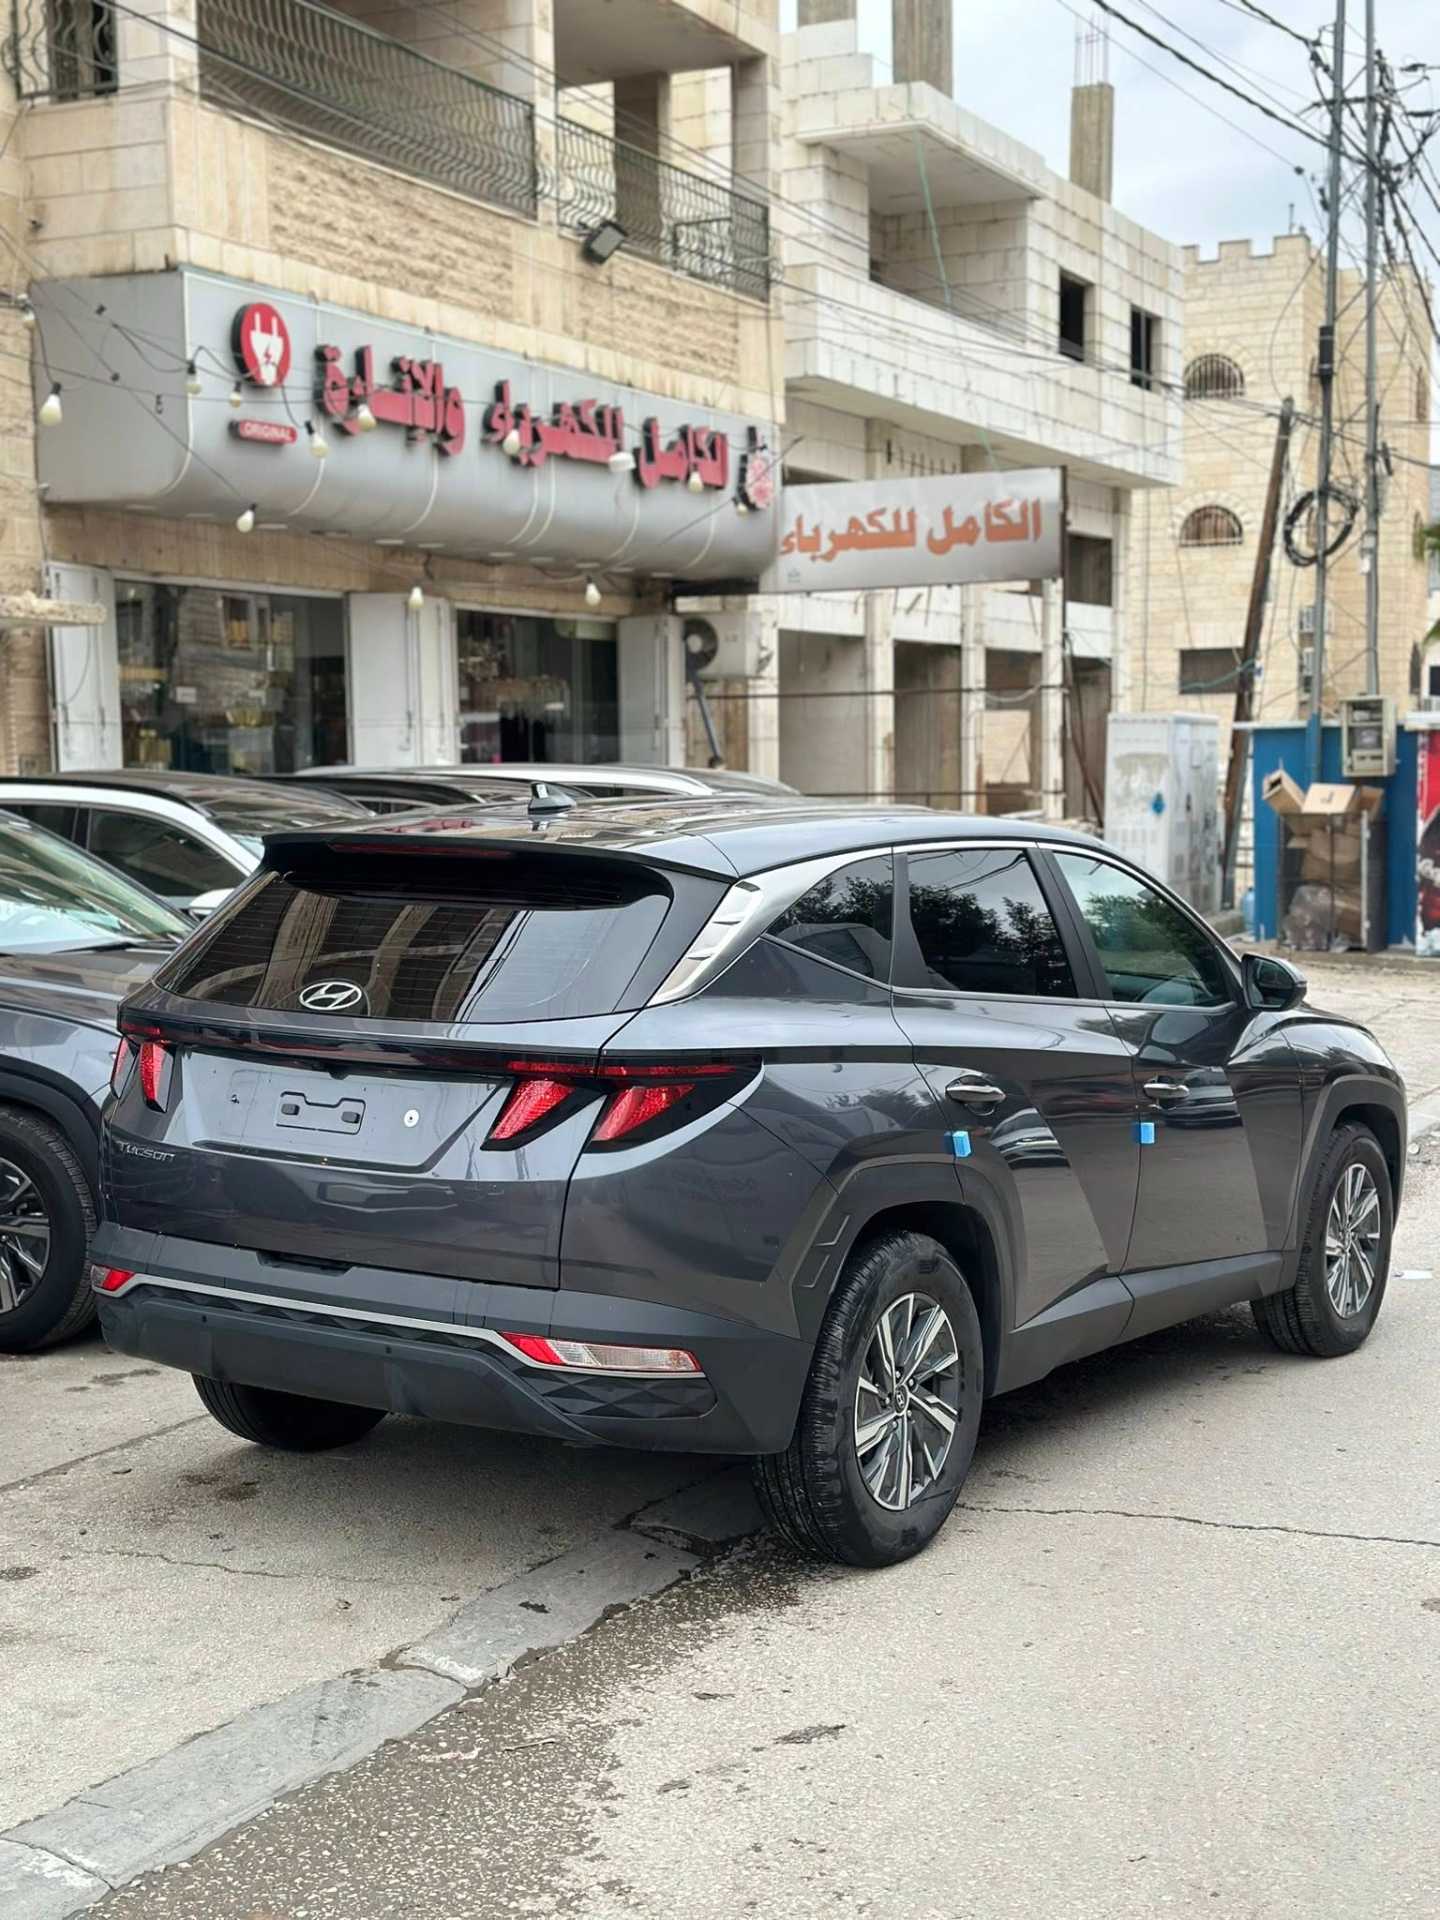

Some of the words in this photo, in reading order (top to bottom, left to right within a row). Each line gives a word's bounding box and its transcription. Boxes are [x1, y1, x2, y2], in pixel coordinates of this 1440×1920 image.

[242, 420, 294, 440] ORIGINAL
[634, 416, 728, 490] الكامل
[779, 505, 918, 563] للكهرباء
[926, 499, 1042, 556] الكامل
[115, 1140, 176, 1162] TUCSON
